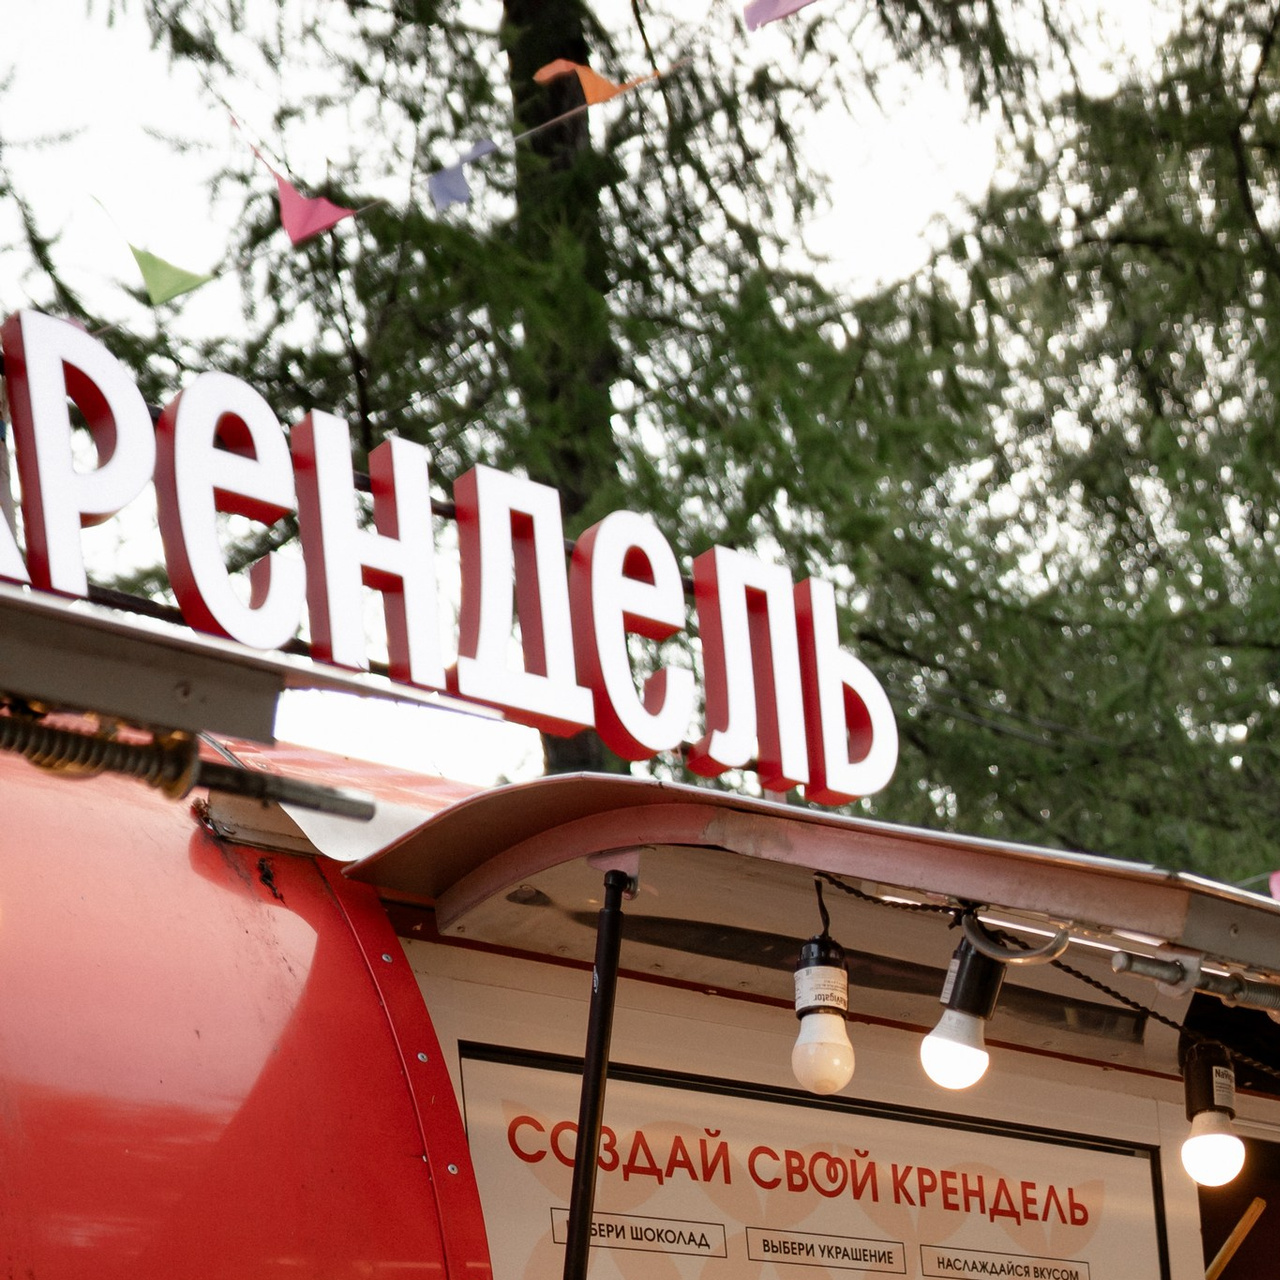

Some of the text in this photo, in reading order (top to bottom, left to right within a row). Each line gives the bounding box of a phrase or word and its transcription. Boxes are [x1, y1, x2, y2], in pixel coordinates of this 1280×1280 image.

[508, 1115, 1089, 1226] СОЗДАЙ СВОЙ КРЕНДЕЛЬ
[567, 1220, 711, 1250] БЕРИ ШОКОЛАД
[763, 1239, 893, 1265] ВЫБЕРИ УКРАШЕНИЕ
[937, 1256, 1031, 1278] НАСЛАЖДАЙСЯ
